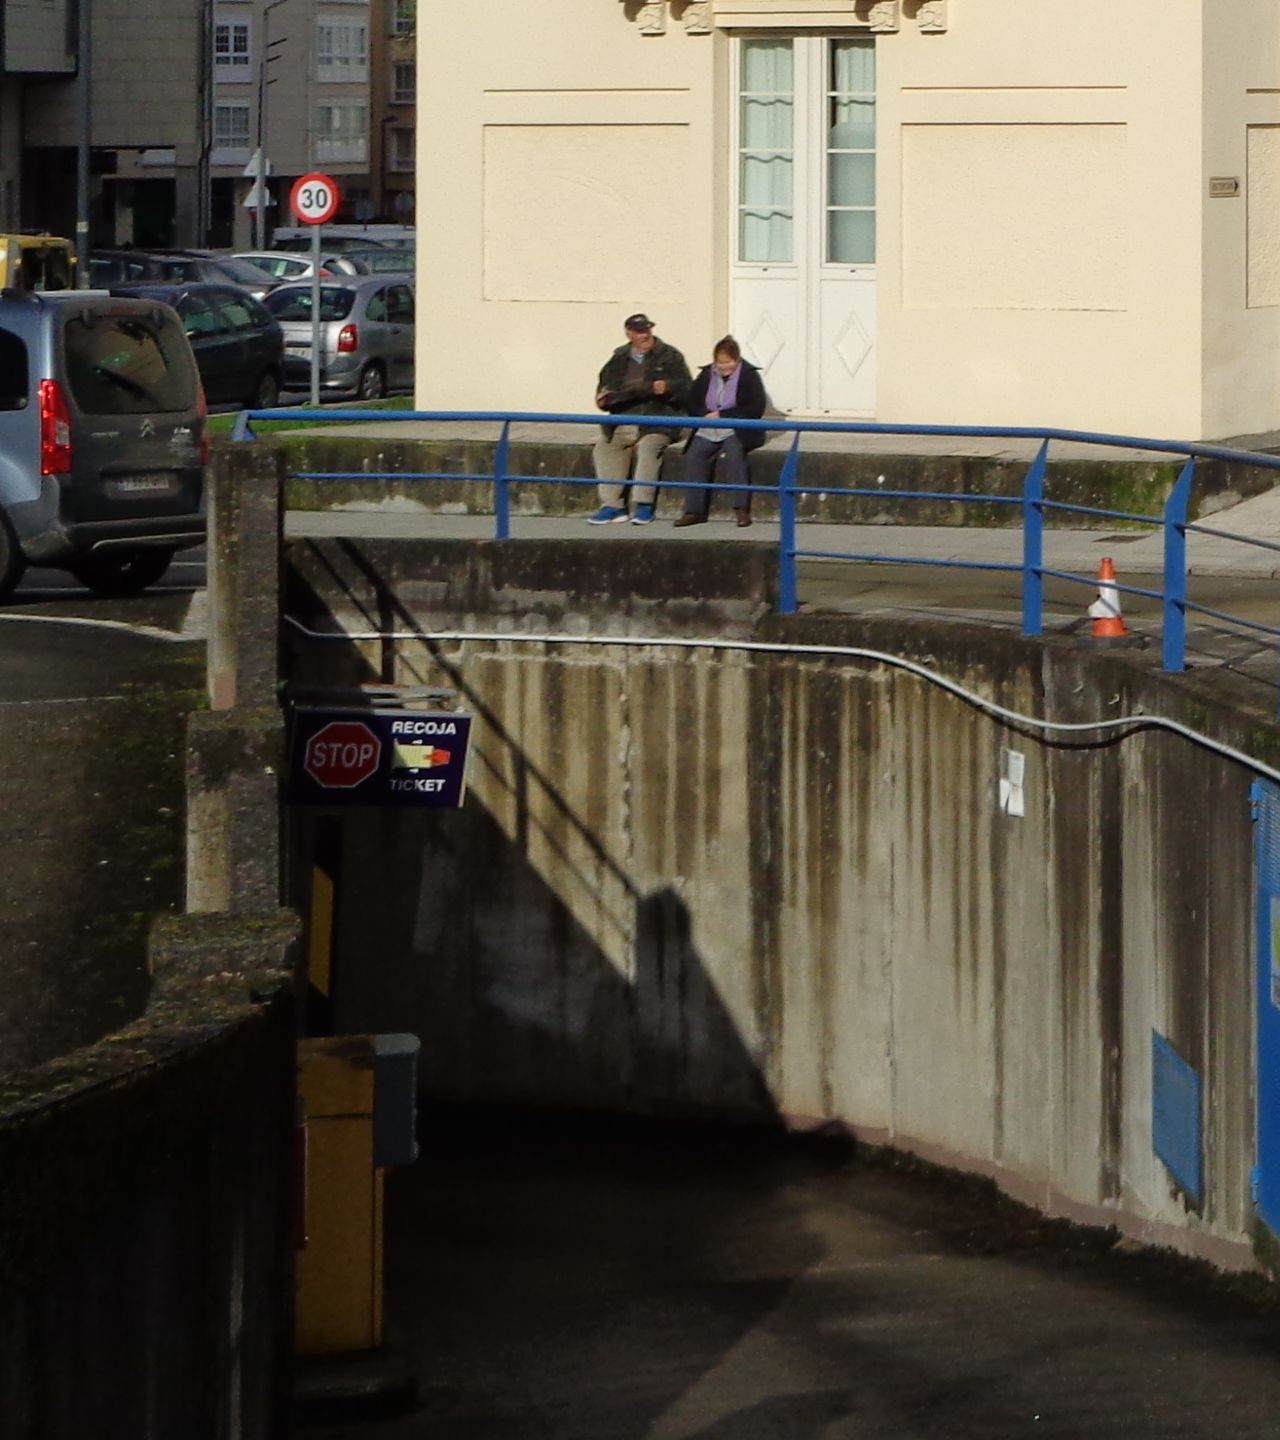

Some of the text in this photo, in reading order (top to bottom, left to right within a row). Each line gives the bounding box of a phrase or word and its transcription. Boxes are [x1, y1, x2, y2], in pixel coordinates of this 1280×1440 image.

[302, 188, 328, 209] 30
[391, 720, 457, 736] RECOJA
[311, 742, 374, 769] STOP
[390, 778, 446, 792] TICKET
